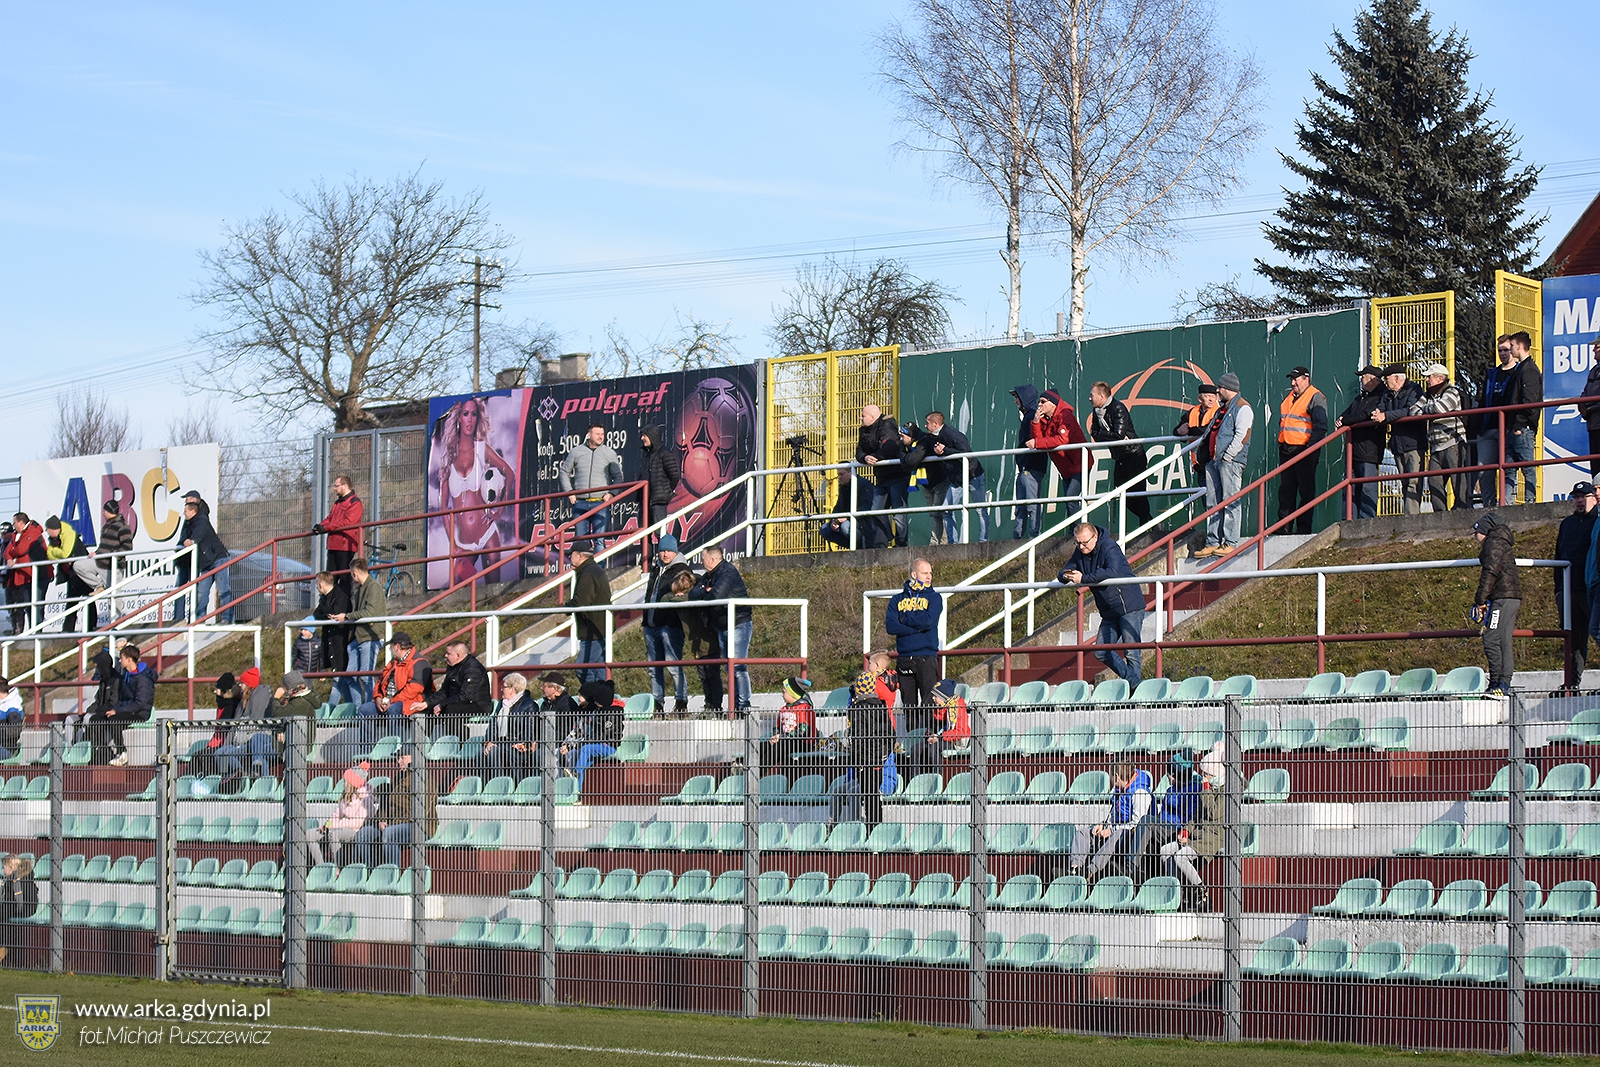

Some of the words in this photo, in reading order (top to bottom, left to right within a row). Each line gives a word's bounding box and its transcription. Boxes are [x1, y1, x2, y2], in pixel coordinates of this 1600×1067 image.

[560, 381, 672, 420] polgraf
[618, 406, 662, 416] SYSTEM
[559, 434, 580, 454] 509
[606, 430, 627, 450] 839
[58, 466, 181, 548] ABC
